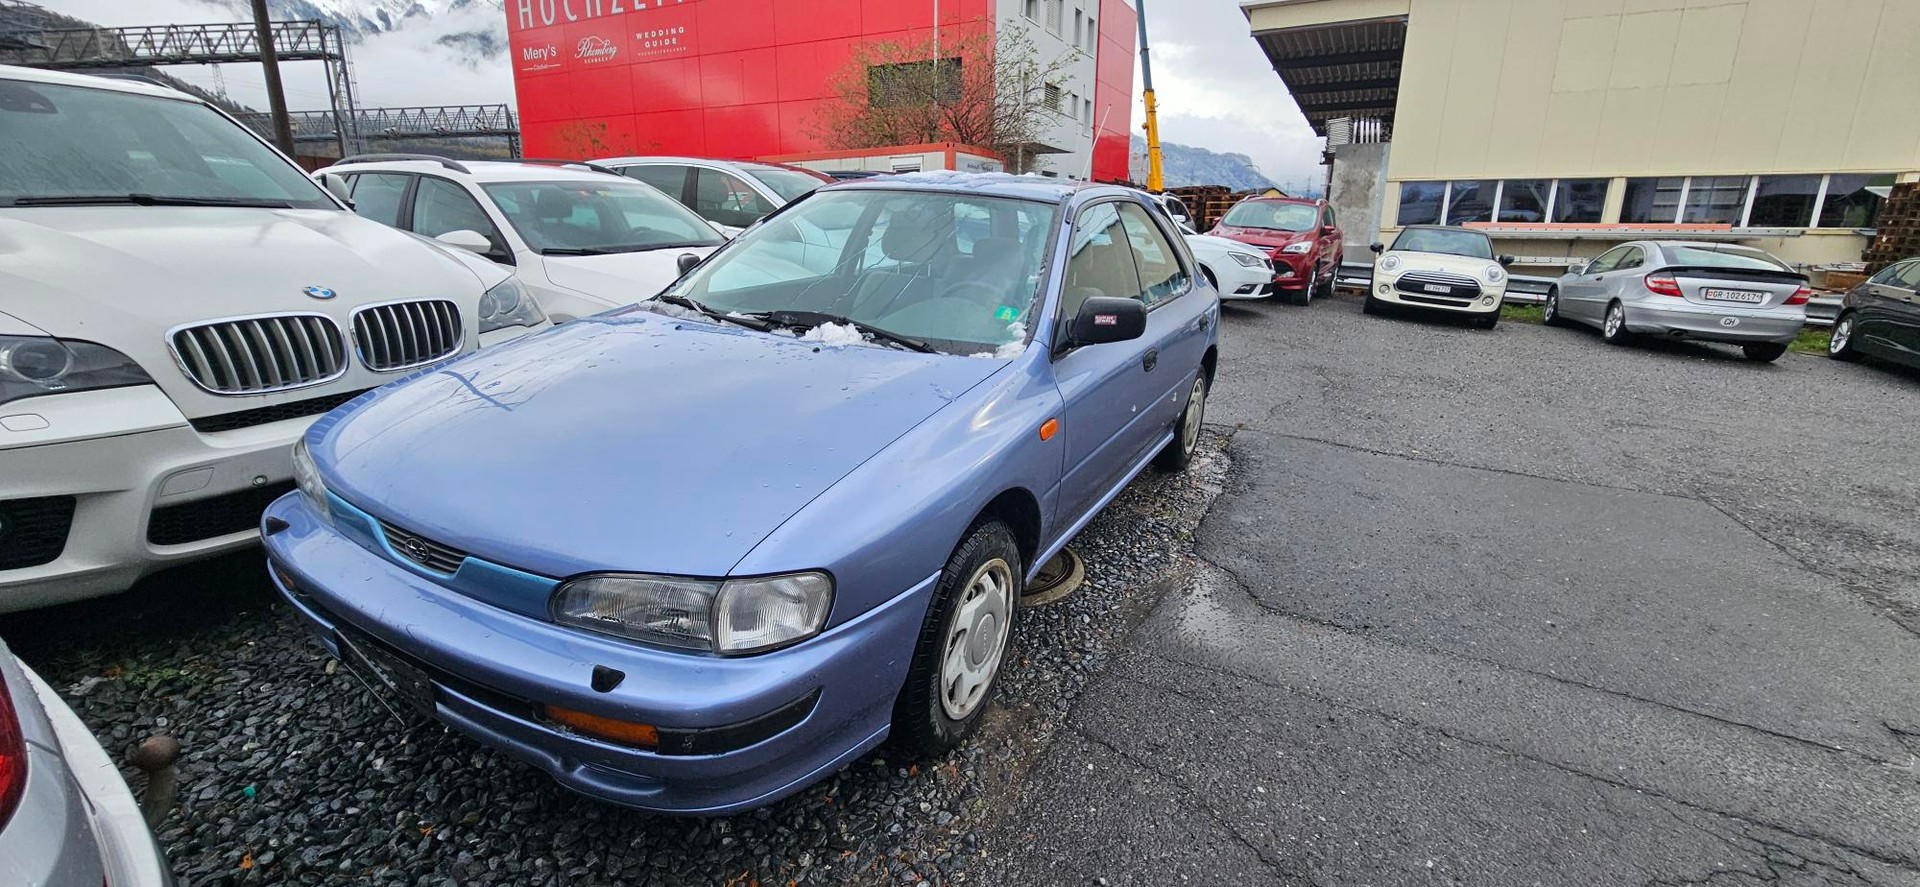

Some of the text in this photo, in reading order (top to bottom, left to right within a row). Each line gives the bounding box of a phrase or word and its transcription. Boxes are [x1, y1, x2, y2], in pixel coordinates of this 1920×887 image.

[518, 0, 683, 29] HOCH
[635, 26, 684, 40] WEDDING
[644, 37, 677, 48] GUIDE
[523, 44, 557, 61] Mery's
[1726, 292, 1756, 300] 102617
[1724, 317, 1735, 325] CH
